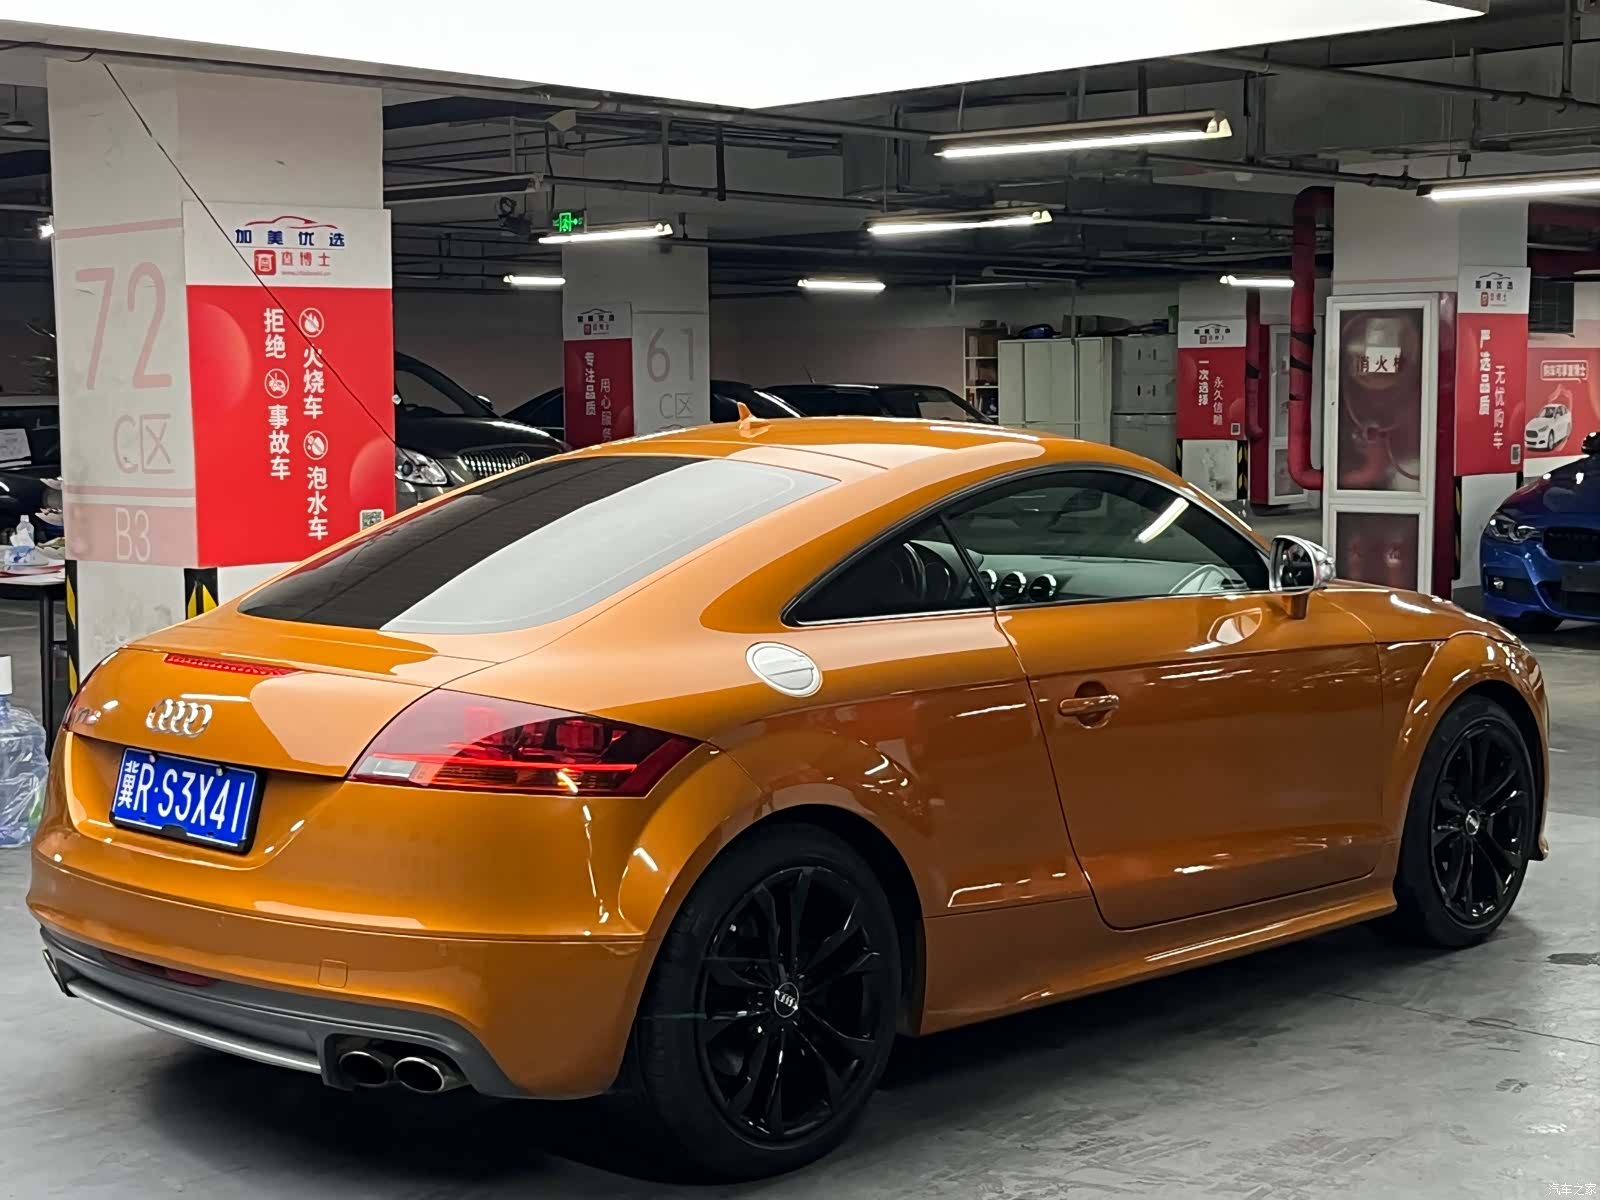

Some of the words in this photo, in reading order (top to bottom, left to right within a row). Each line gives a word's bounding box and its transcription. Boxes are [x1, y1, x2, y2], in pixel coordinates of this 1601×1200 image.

[235, 229, 345, 247] 加美优选
[76, 262, 172, 390] 72
[263, 308, 287, 359] 拒绝
[647, 327, 694, 383] 61
[303, 343, 326, 420] 火烧车
[659, 392, 694, 419] C区
[112, 414, 175, 475] C区
[268, 404, 291, 481] 事故车
[307, 466, 329, 541] 泡水车
[115, 507, 150, 562] B3
